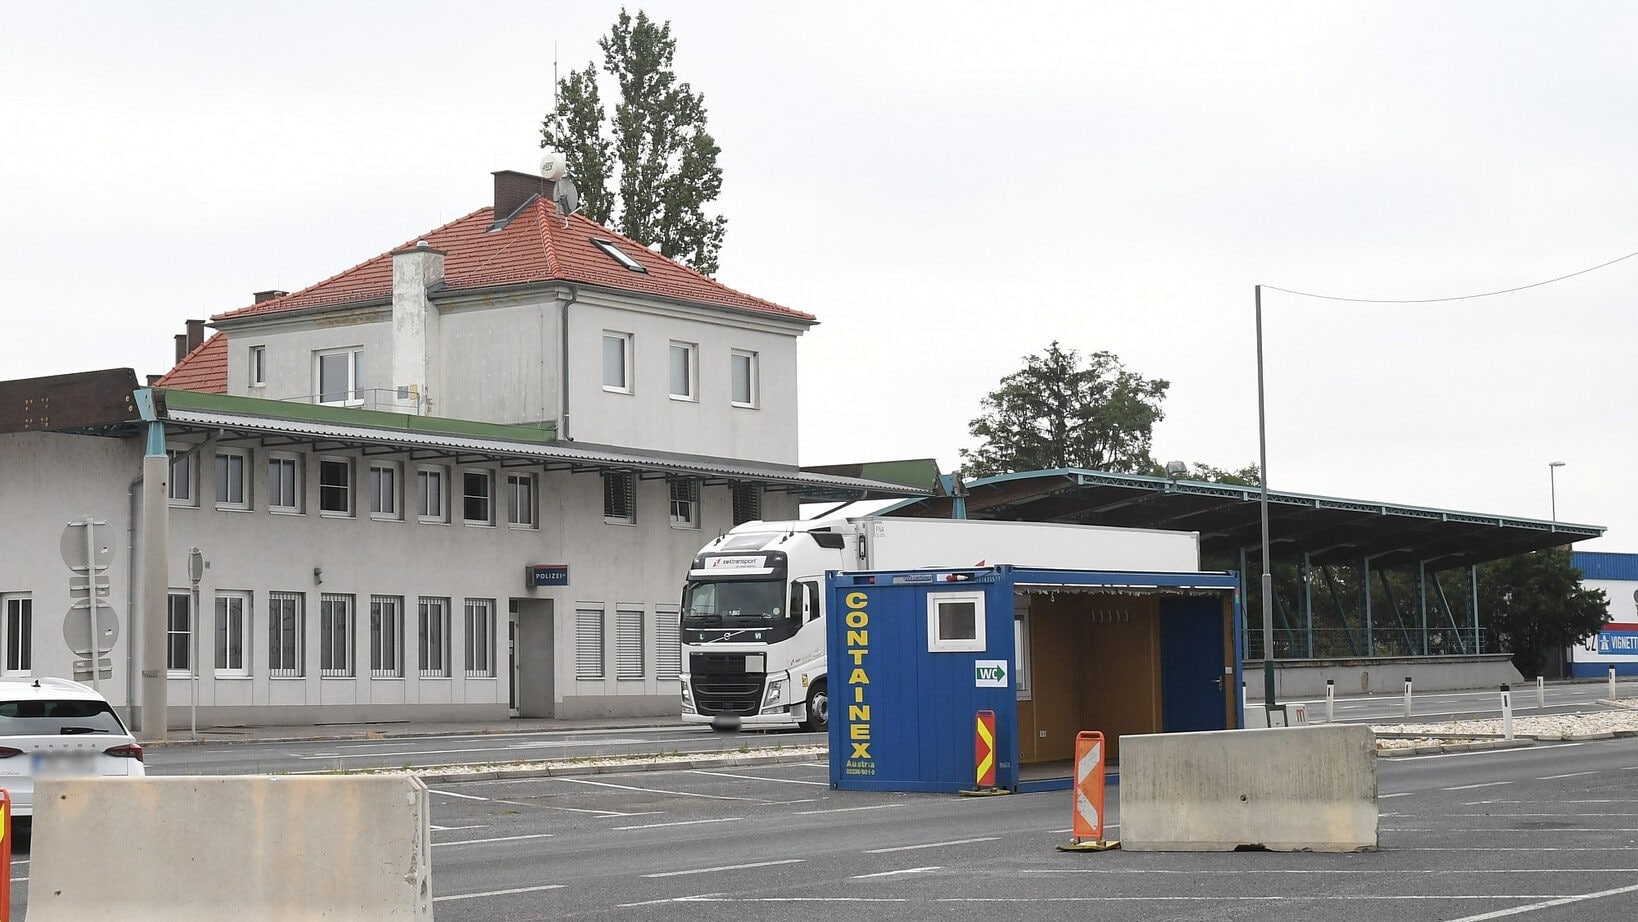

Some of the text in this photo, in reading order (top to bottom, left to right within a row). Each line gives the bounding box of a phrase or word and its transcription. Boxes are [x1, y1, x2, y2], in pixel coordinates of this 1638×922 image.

[846, 592, 871, 759] CONTAINEX
[980, 669, 998, 679] WC
[846, 760, 875, 768] Austria
